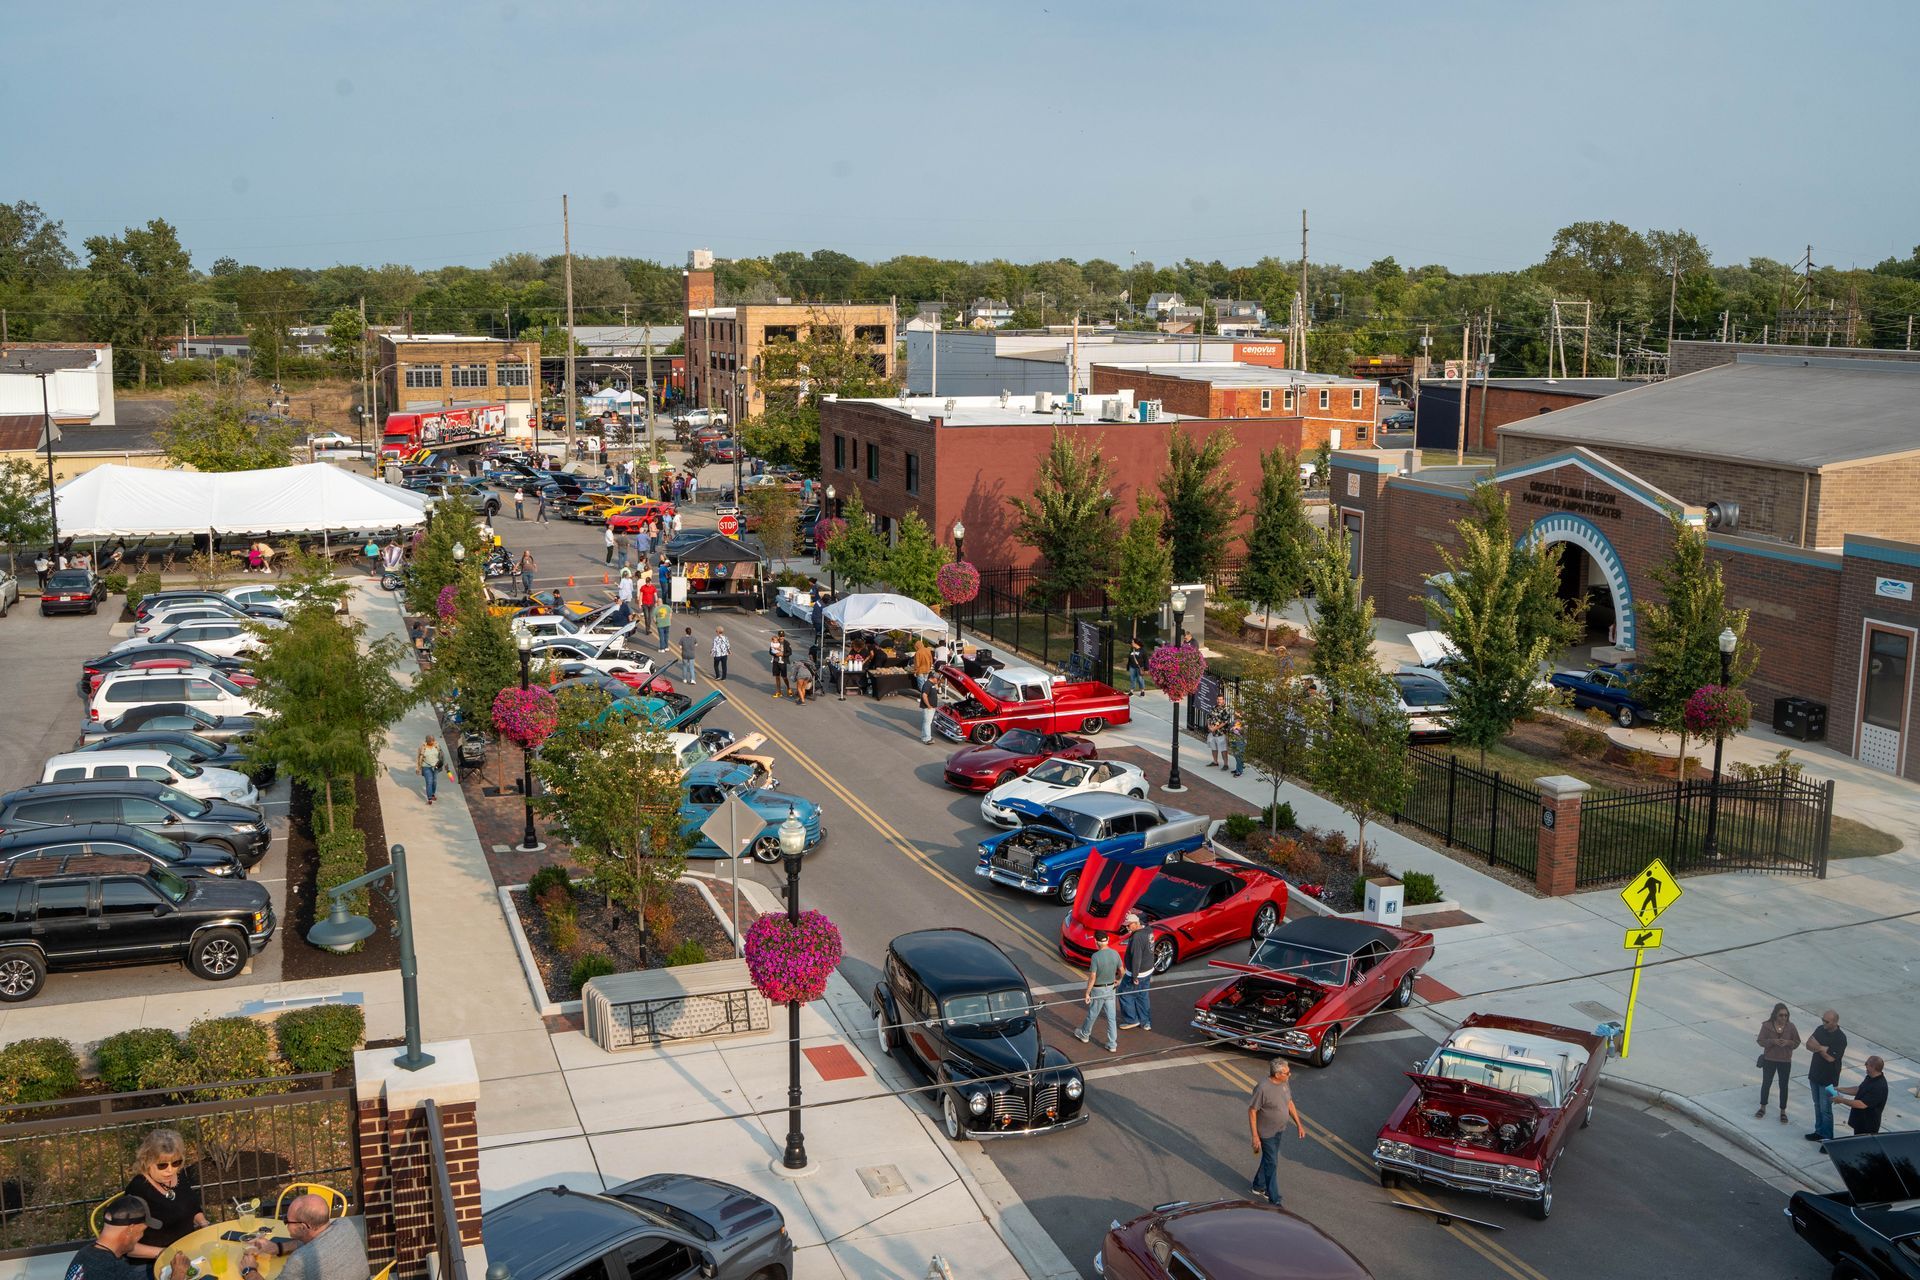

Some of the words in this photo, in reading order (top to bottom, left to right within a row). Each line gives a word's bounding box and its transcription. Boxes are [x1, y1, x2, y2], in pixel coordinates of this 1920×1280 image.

[1530, 481, 1562, 495] GREATER
[1564, 487, 1583, 499] LIMA
[1585, 490, 1616, 504] REGION
[1522, 492, 1542, 504] PARK
[1544, 497, 1560, 508] AND
[1562, 500, 1622, 519] AMPHITHEATER
[719, 521, 737, 530] STOP
